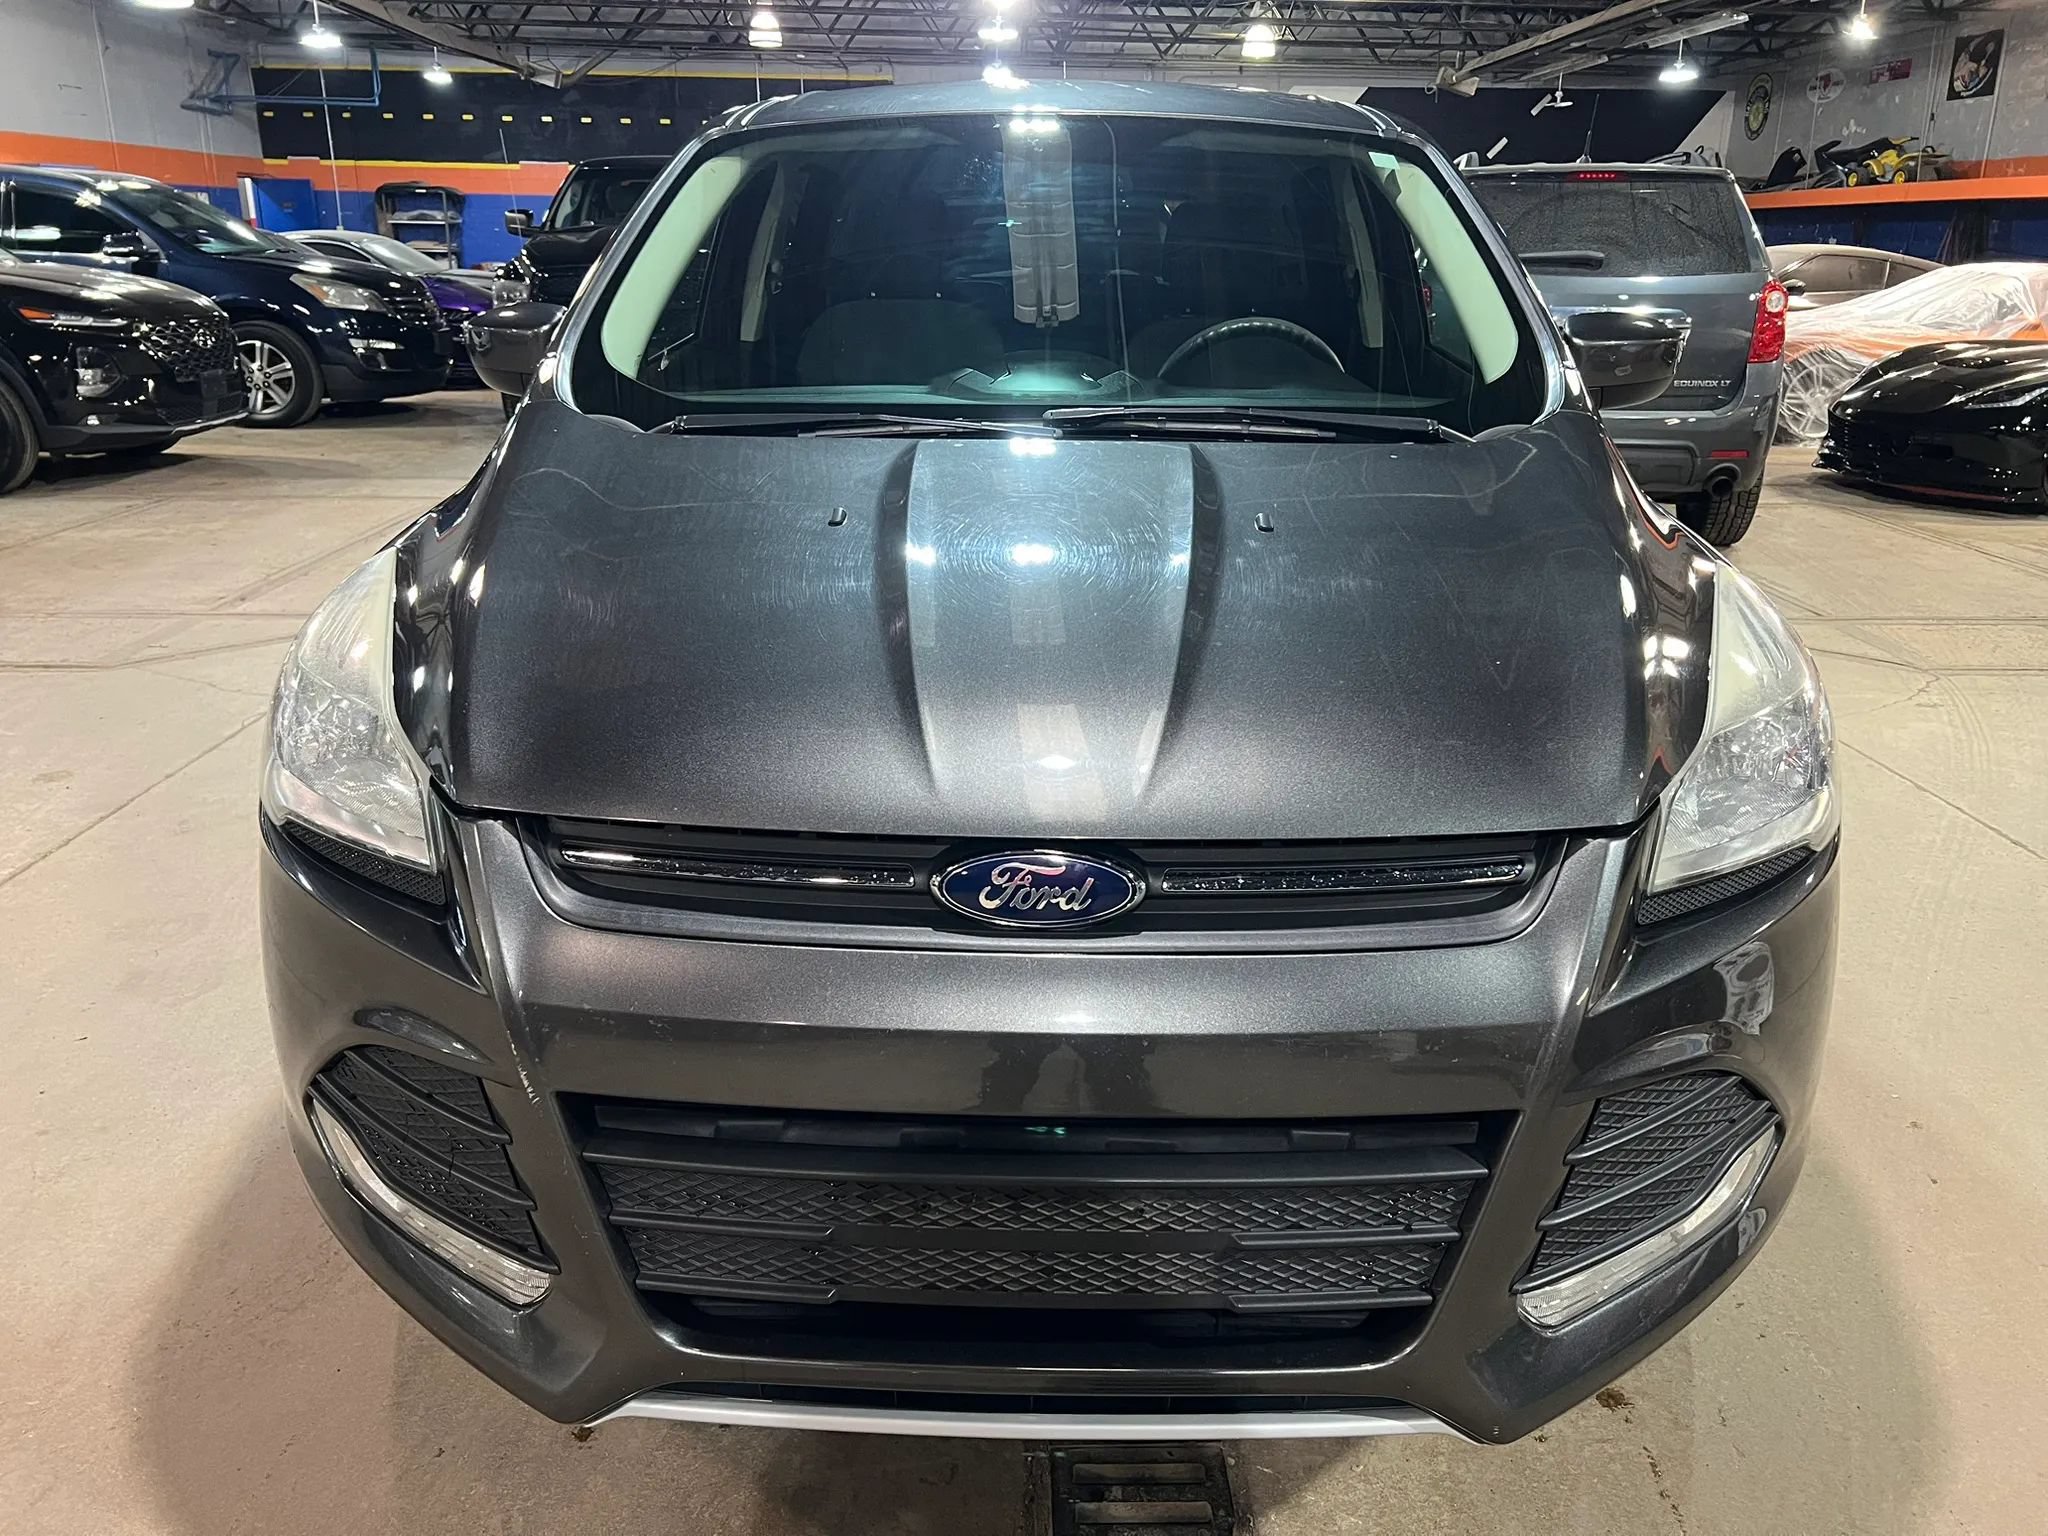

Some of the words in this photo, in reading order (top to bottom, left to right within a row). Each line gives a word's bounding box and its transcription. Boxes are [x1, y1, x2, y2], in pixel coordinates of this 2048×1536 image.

[1673, 379, 1719, 388] EQUINOX
[1720, 379, 1732, 388] LT
[978, 862, 1095, 912] Ford
